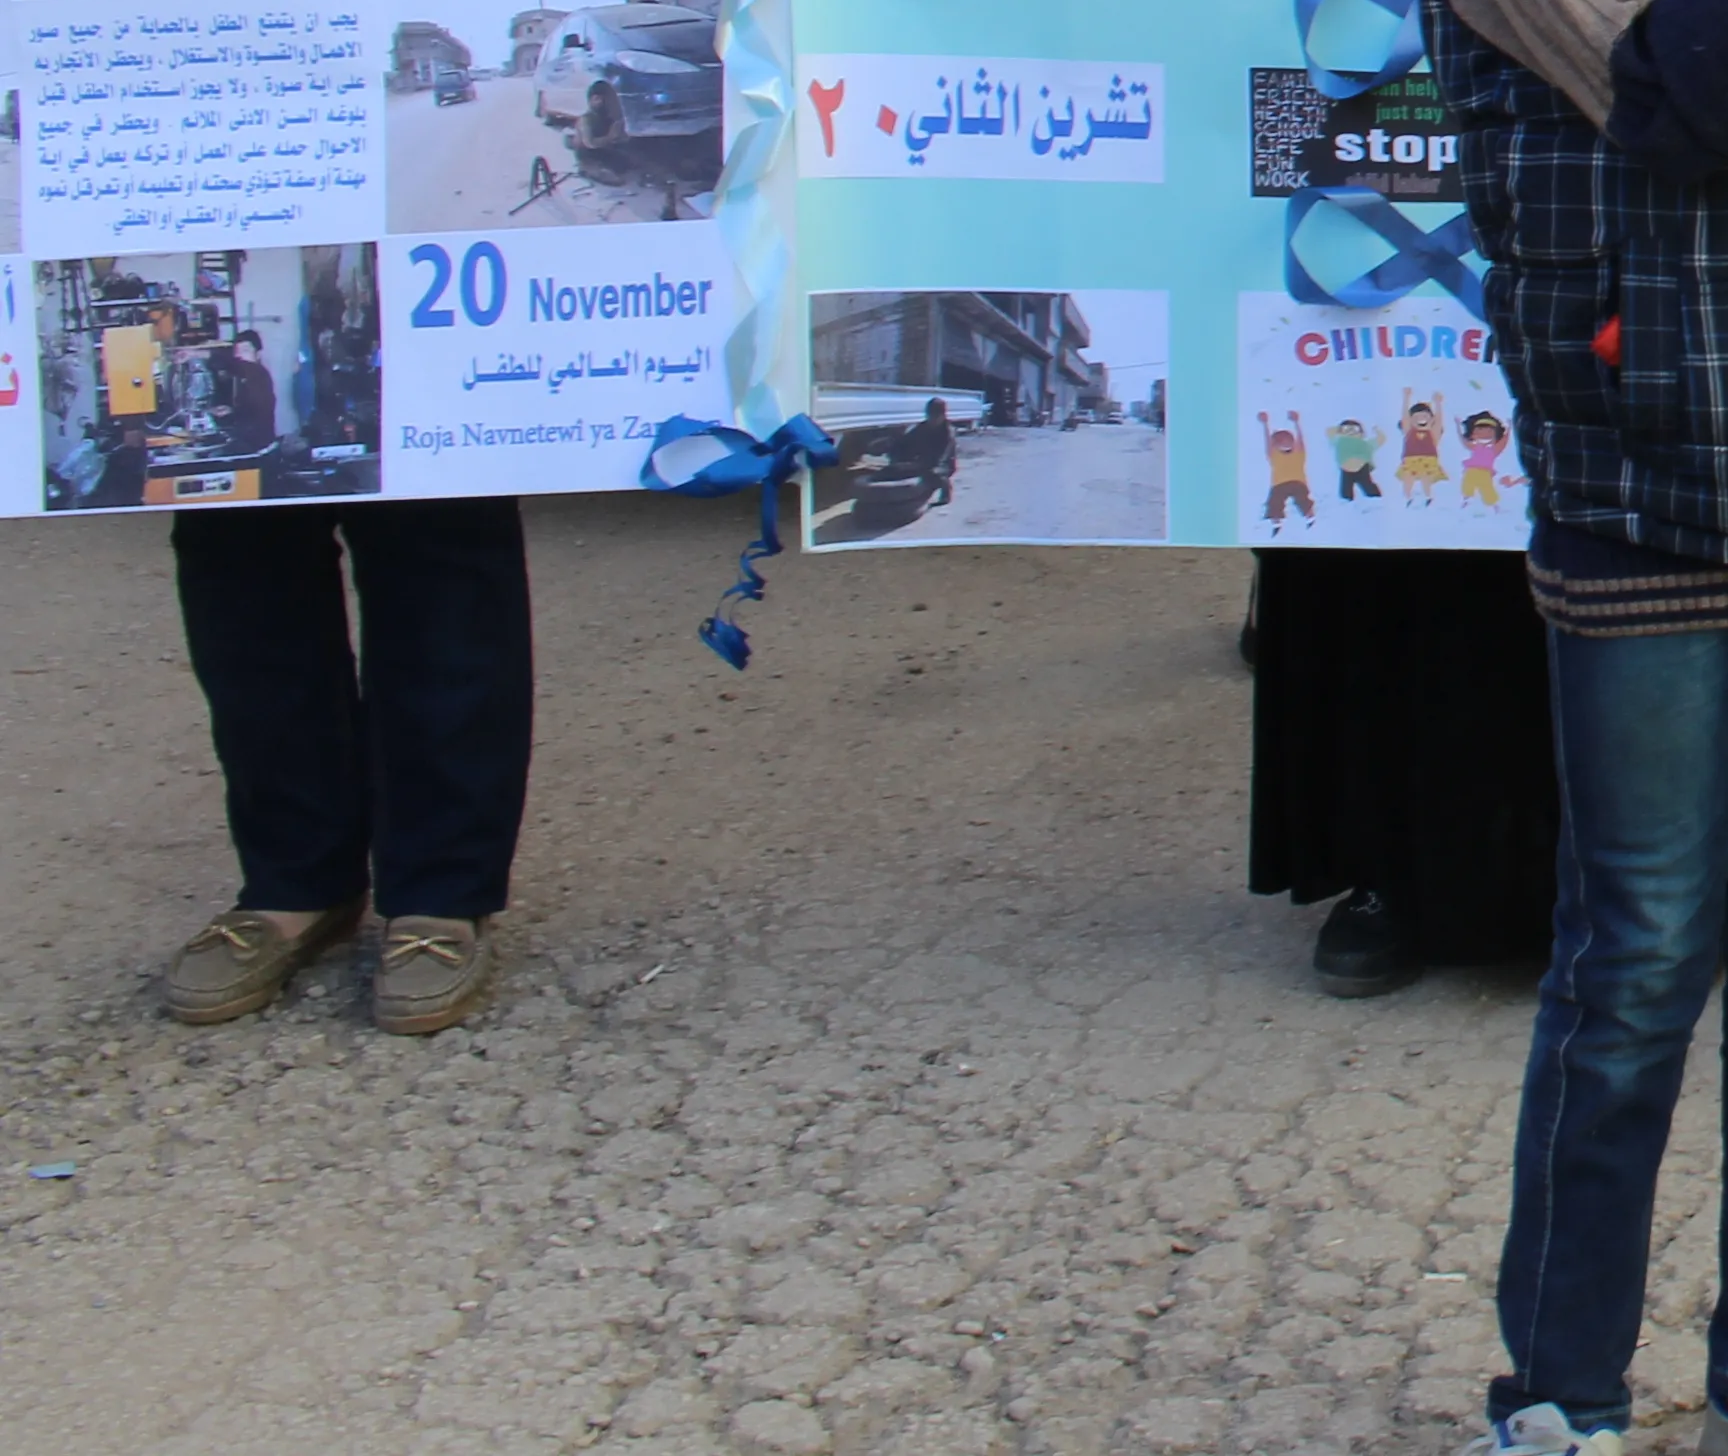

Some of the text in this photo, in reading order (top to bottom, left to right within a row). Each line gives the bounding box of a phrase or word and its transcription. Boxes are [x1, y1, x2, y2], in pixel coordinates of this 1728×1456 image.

[1254, 72, 1317, 89] FAMIL
[905, 68, 1019, 165] الثاني
[1031, 74, 1151, 160] تشرين
[1375, 102, 1444, 125] just say
[1254, 121, 1325, 140] SCHOOL
[1255, 135, 1304, 154] LIFE
[1255, 155, 1295, 171] FUN
[1335, 129, 1459, 171] stop
[1255, 171, 1311, 189] WORK
[408, 241, 712, 328] 20 November
[462, 346, 711, 394] اليوم العالمي للطفل
[401, 418, 616, 455] Roja Navnetewî ya
